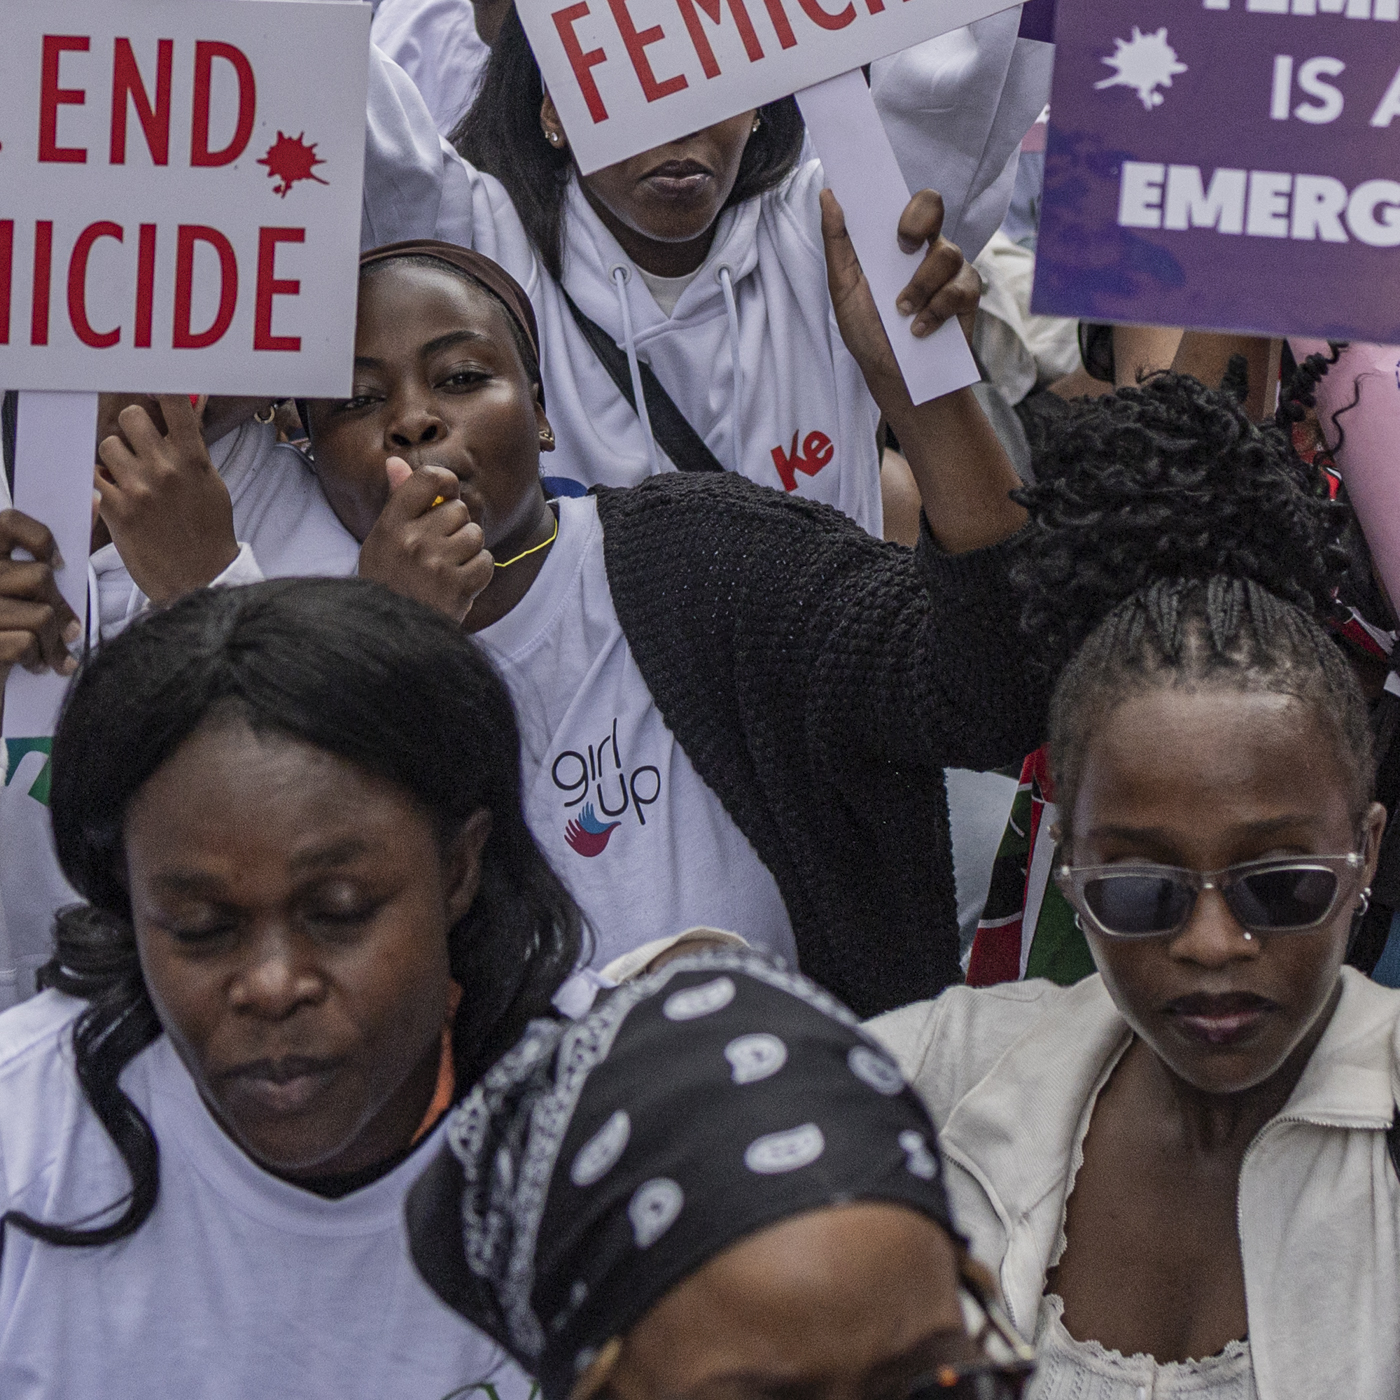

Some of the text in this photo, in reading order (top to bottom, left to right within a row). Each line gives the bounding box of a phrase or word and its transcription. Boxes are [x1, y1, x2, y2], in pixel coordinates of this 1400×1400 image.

[36, 33, 258, 169] END
[1269, 54, 1346, 125] IS
[551, 717, 623, 808] girl
[597, 763, 661, 826] up
